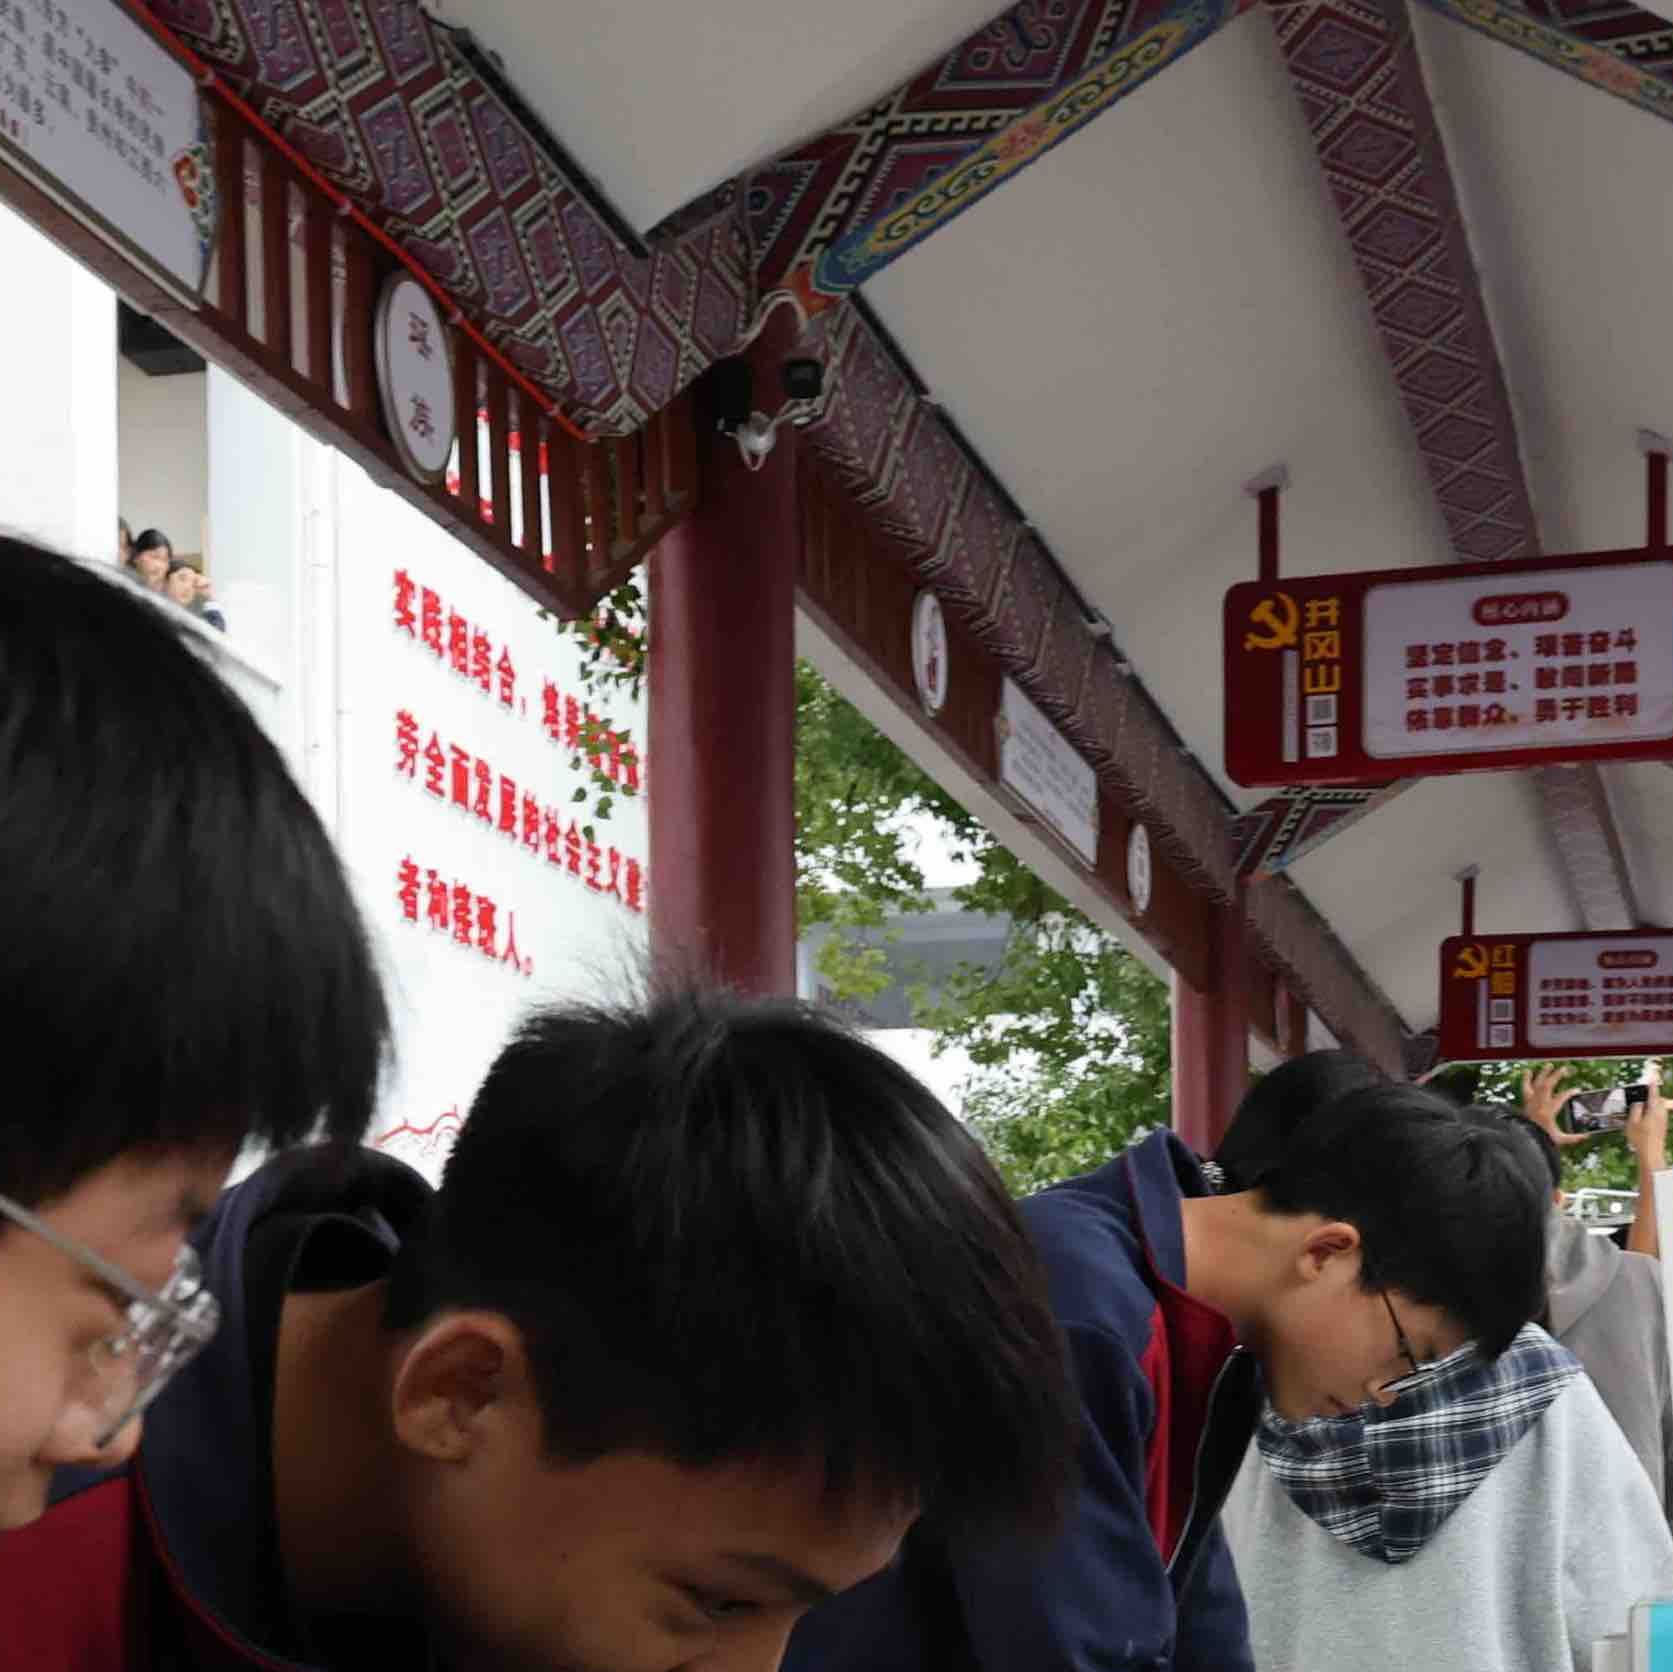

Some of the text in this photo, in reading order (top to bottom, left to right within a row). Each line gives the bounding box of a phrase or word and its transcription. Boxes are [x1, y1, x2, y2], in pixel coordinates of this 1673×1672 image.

[1304, 597, 1341, 693] 井冈山
[1405, 627, 1638, 669] 坚定信念、艰苦奋斗
